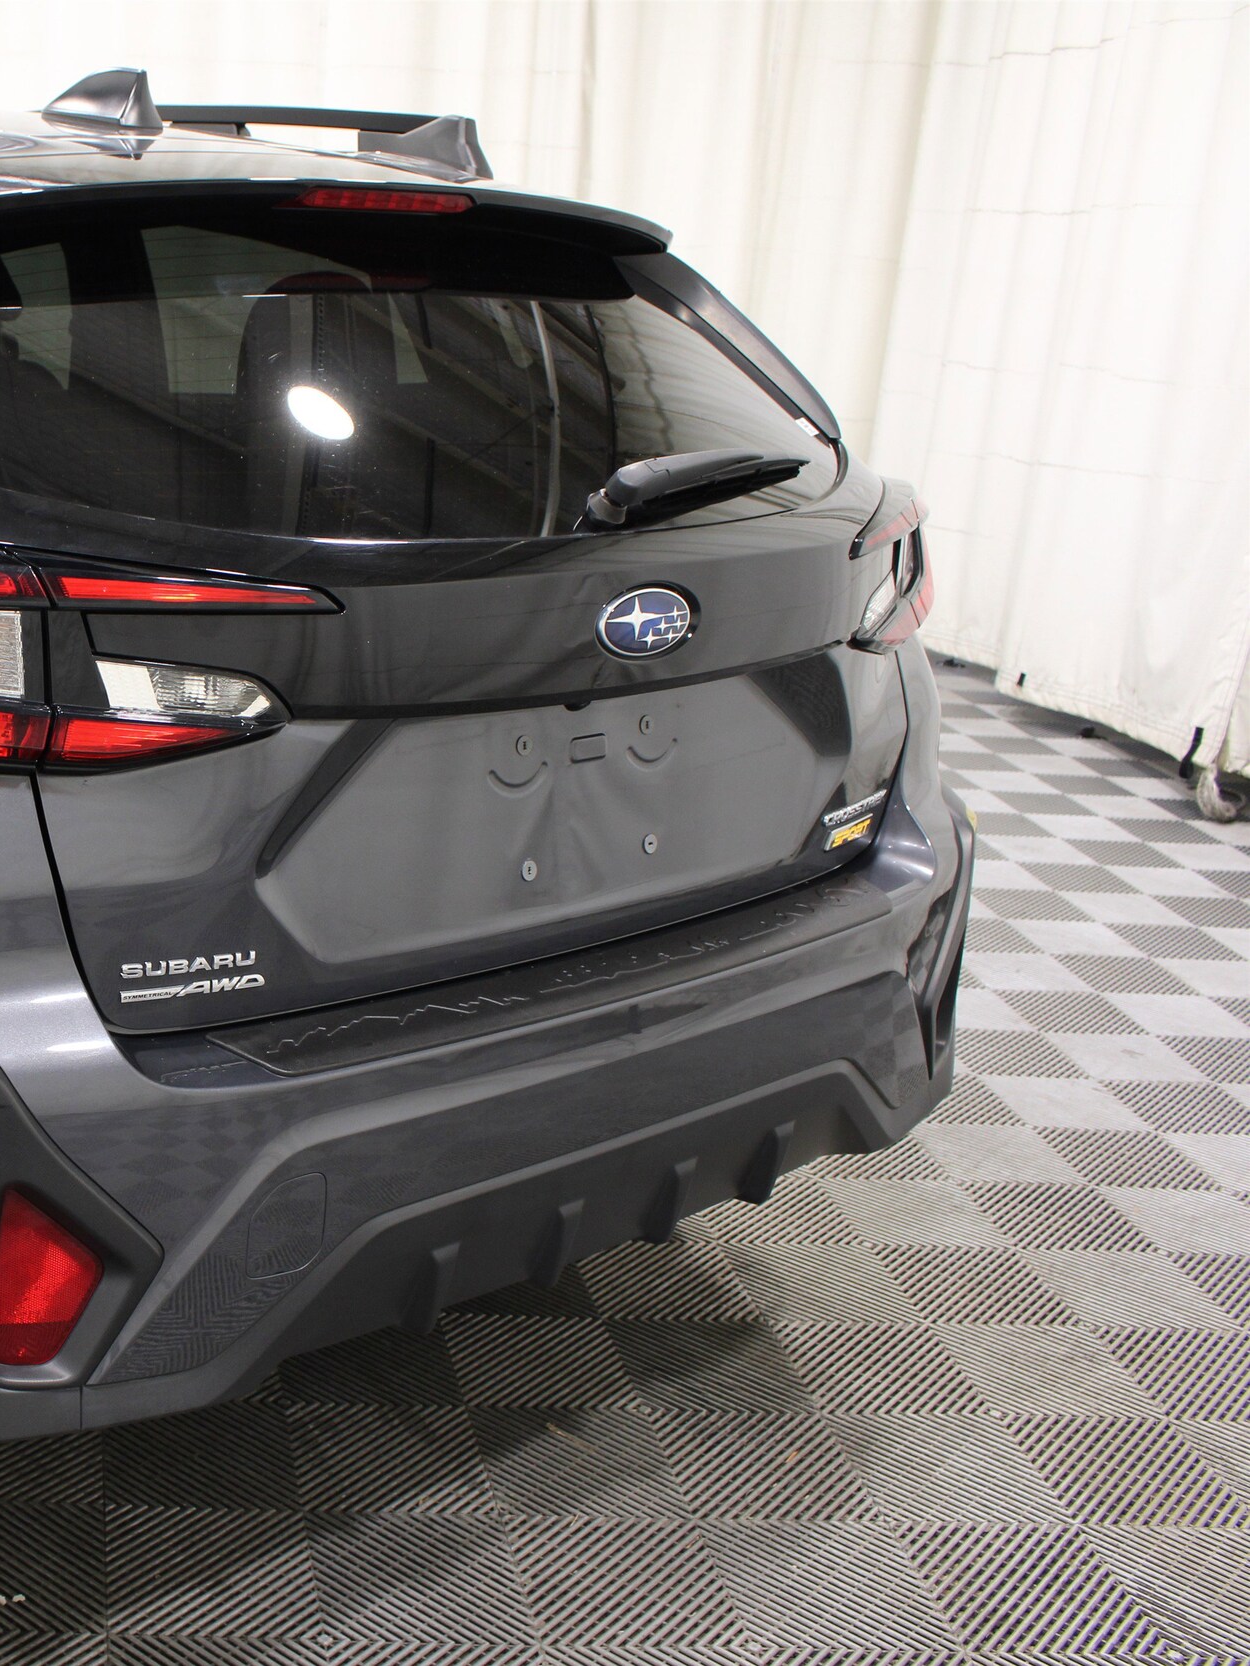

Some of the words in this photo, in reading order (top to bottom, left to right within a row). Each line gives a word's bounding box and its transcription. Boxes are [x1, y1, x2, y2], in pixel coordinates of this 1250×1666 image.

[120, 950, 256, 979] SUBARU
[123, 991, 173, 1001] SYMMETRICAL
[176, 973, 266, 998] AWD
